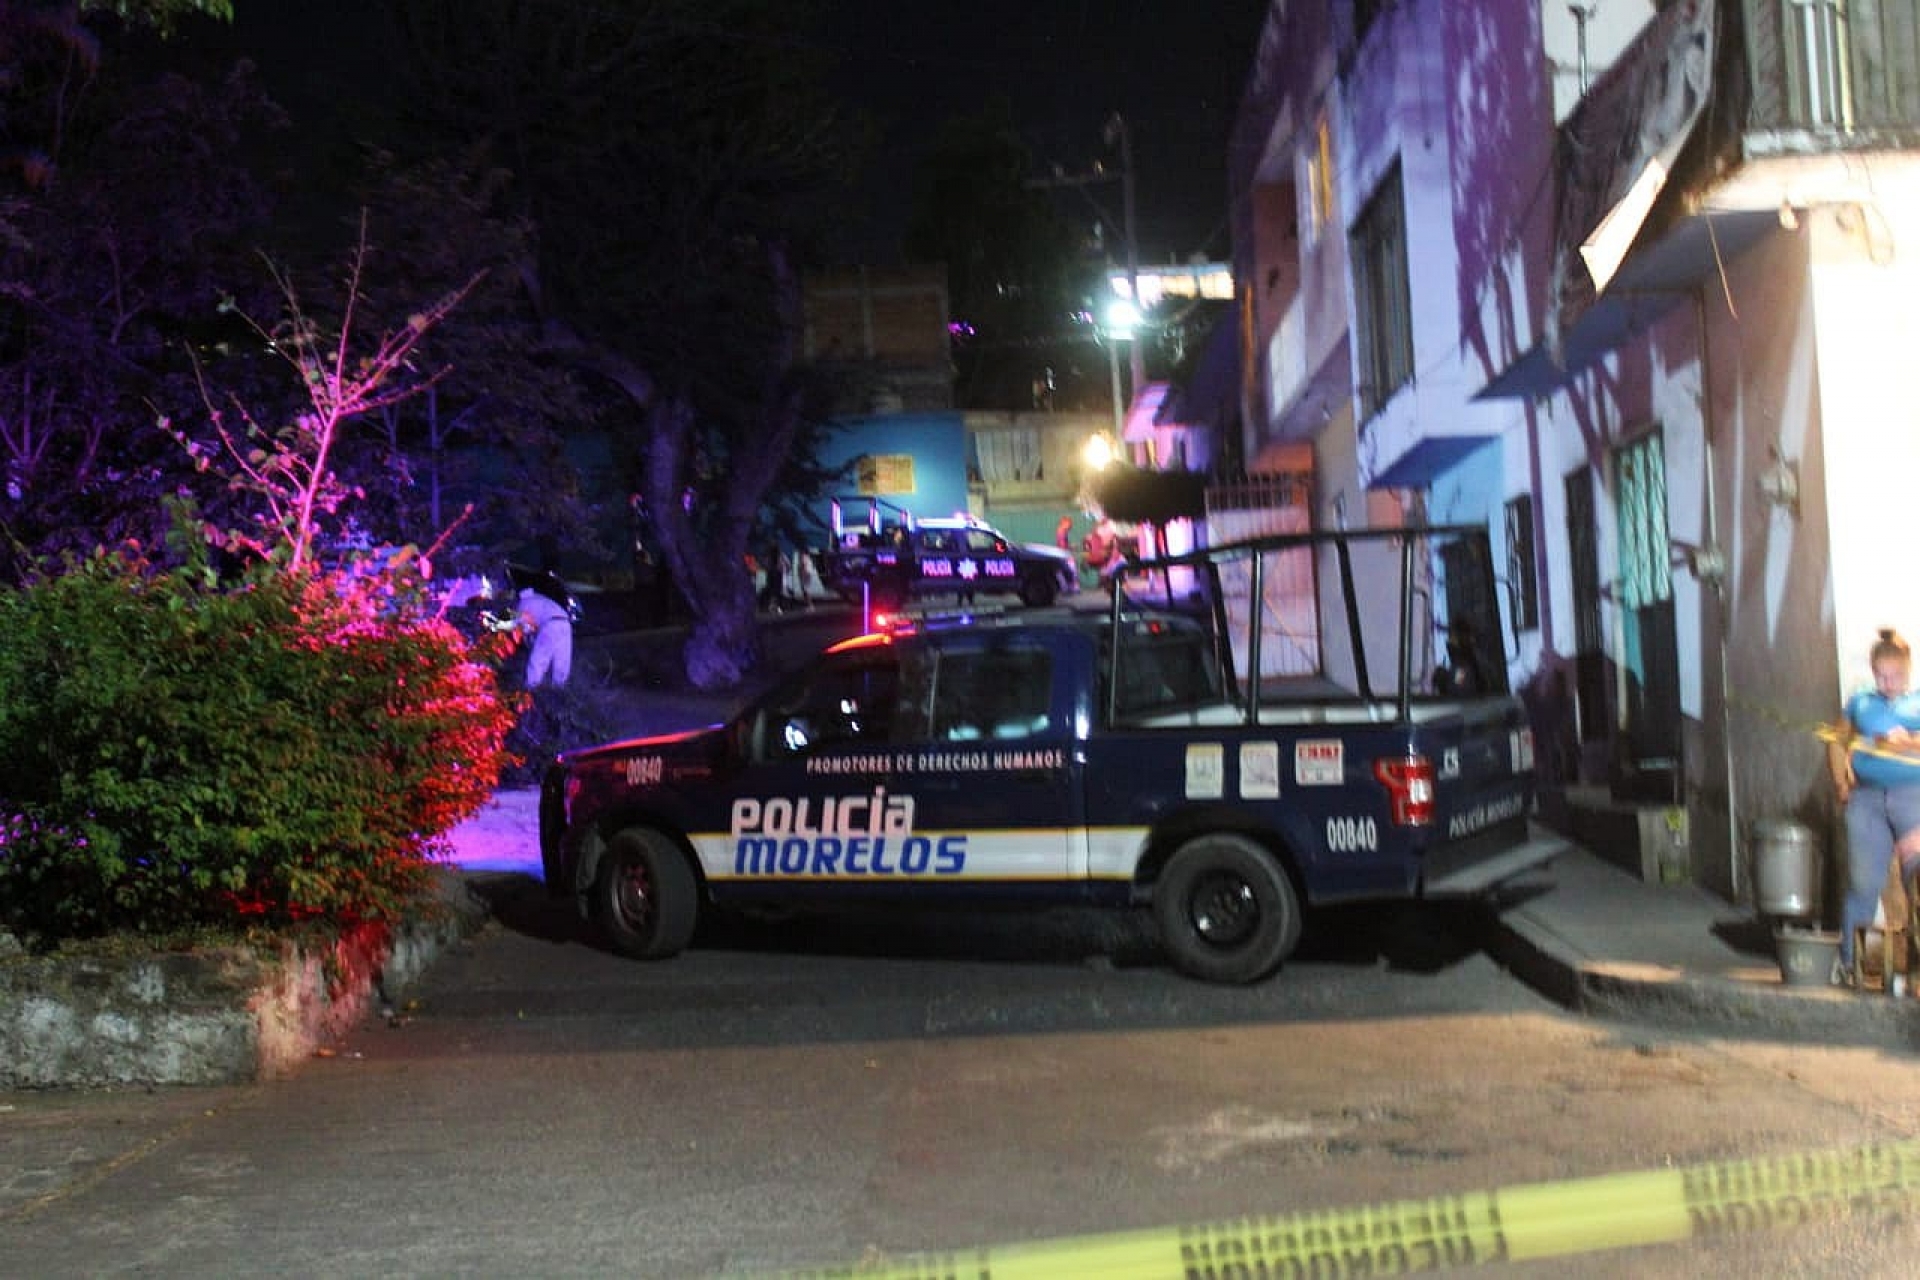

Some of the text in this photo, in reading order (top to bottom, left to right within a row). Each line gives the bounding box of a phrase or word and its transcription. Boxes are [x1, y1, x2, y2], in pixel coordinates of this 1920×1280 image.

[806, 748, 1062, 774] PROMOTORES DE DERECHOS HUMANOS
[1326, 815, 1377, 852] 00840
[734, 836, 968, 875] MORELOS
